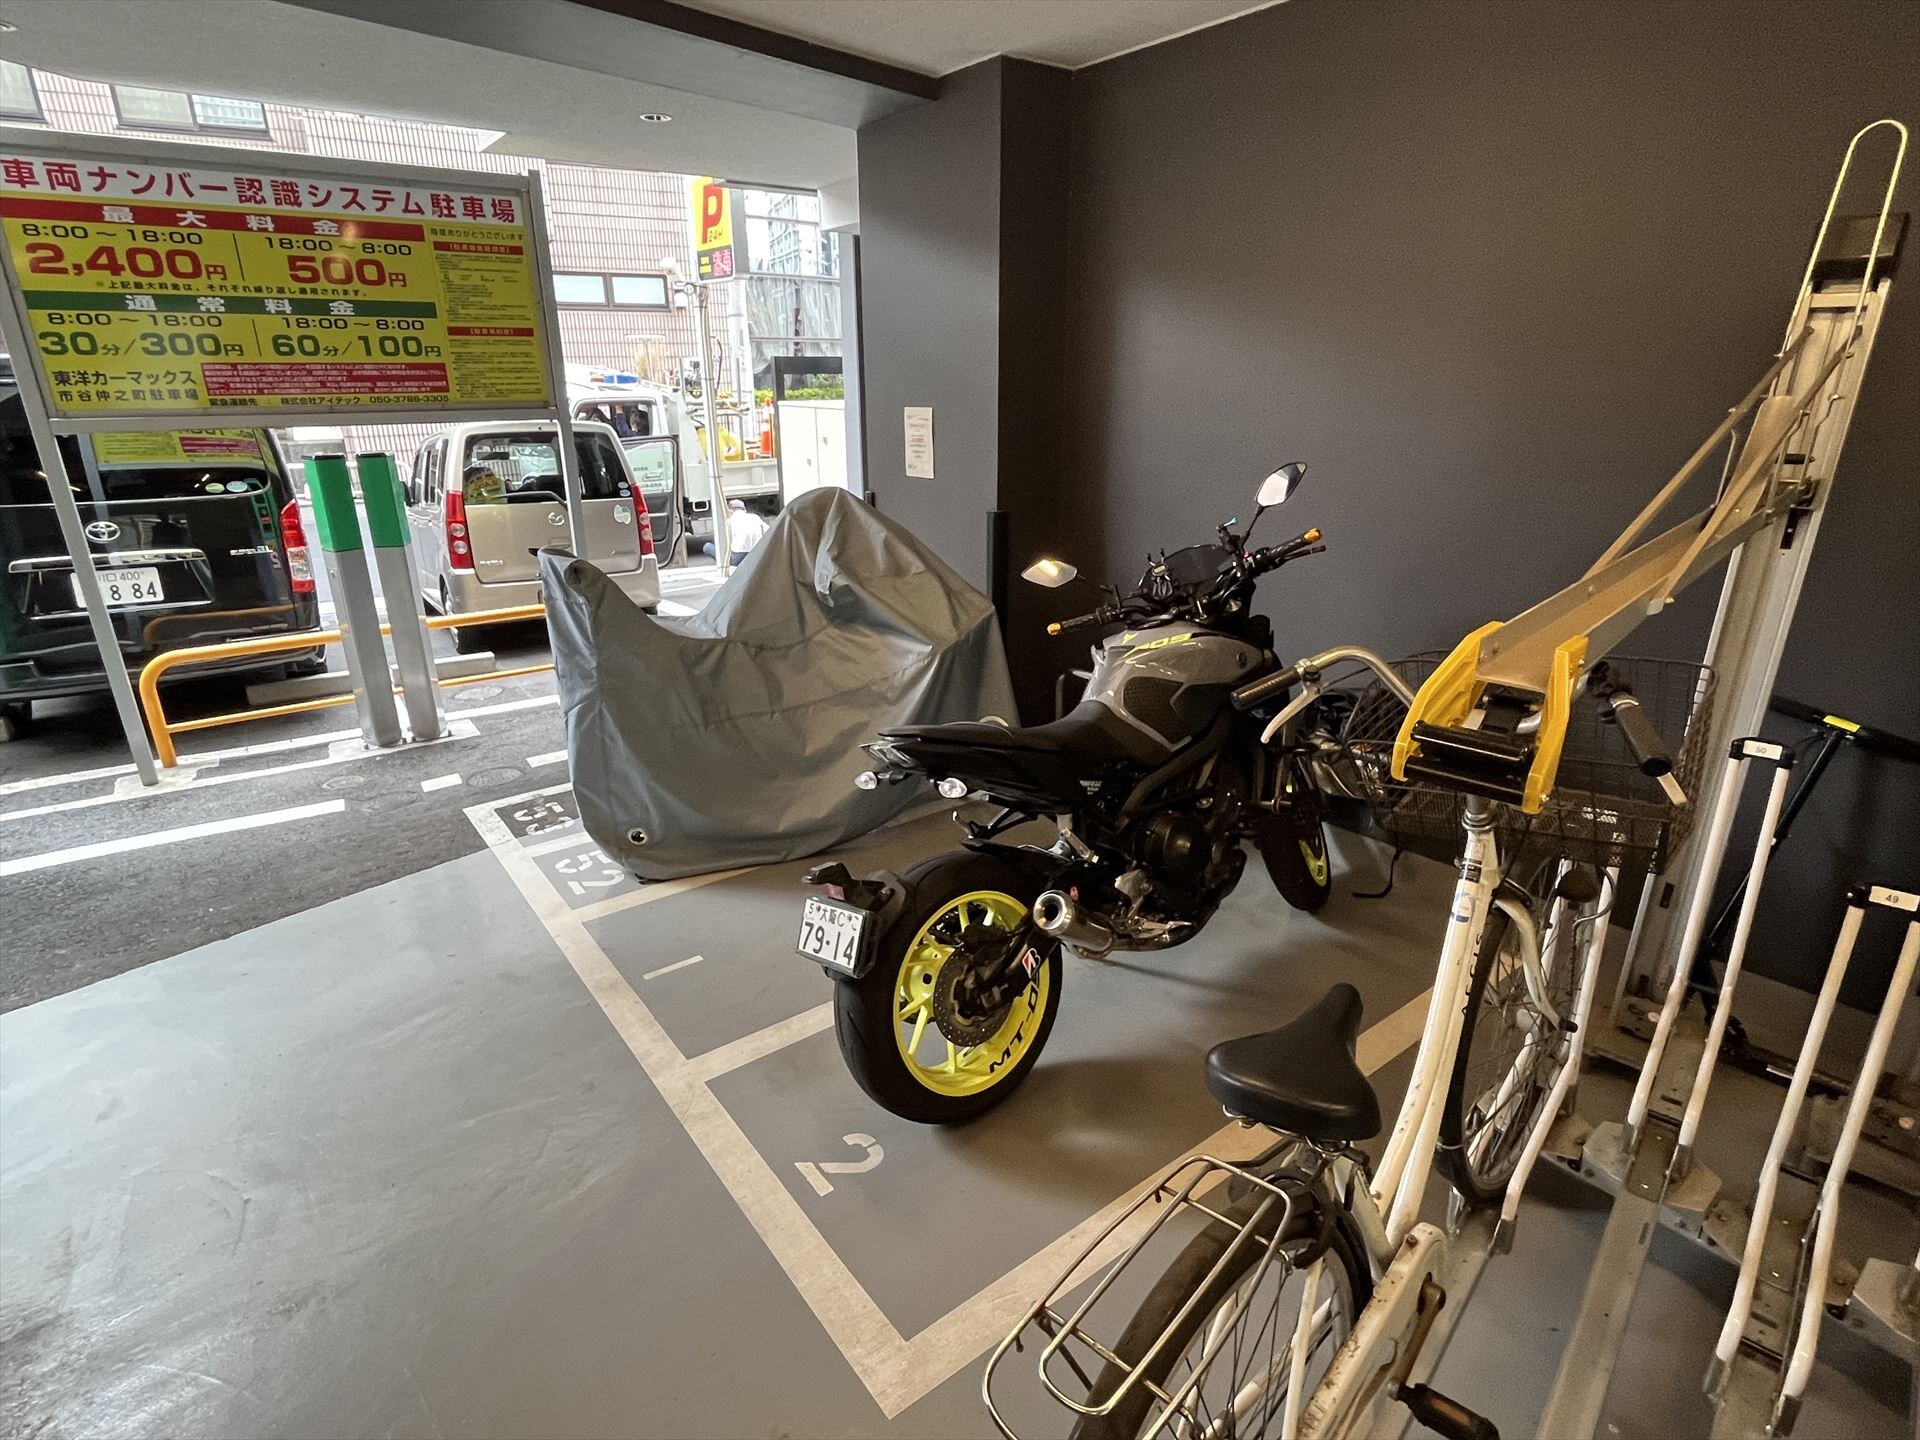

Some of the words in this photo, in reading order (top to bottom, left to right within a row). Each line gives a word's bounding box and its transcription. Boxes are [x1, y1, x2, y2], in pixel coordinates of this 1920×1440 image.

[1, 159, 516, 224] 車両ナンバー認識システム駐車場
[702, 184, 723, 244] P
[52, 370, 197, 387] 東洋カーマックス
[58, 388, 199, 403] 市谷仲之町駐車場
[1755, 745, 1767, 754] 50
[1885, 894, 1899, 904] 49
[989, 984, 1039, 1073] MT-0
[794, 1132, 884, 1197] 2
